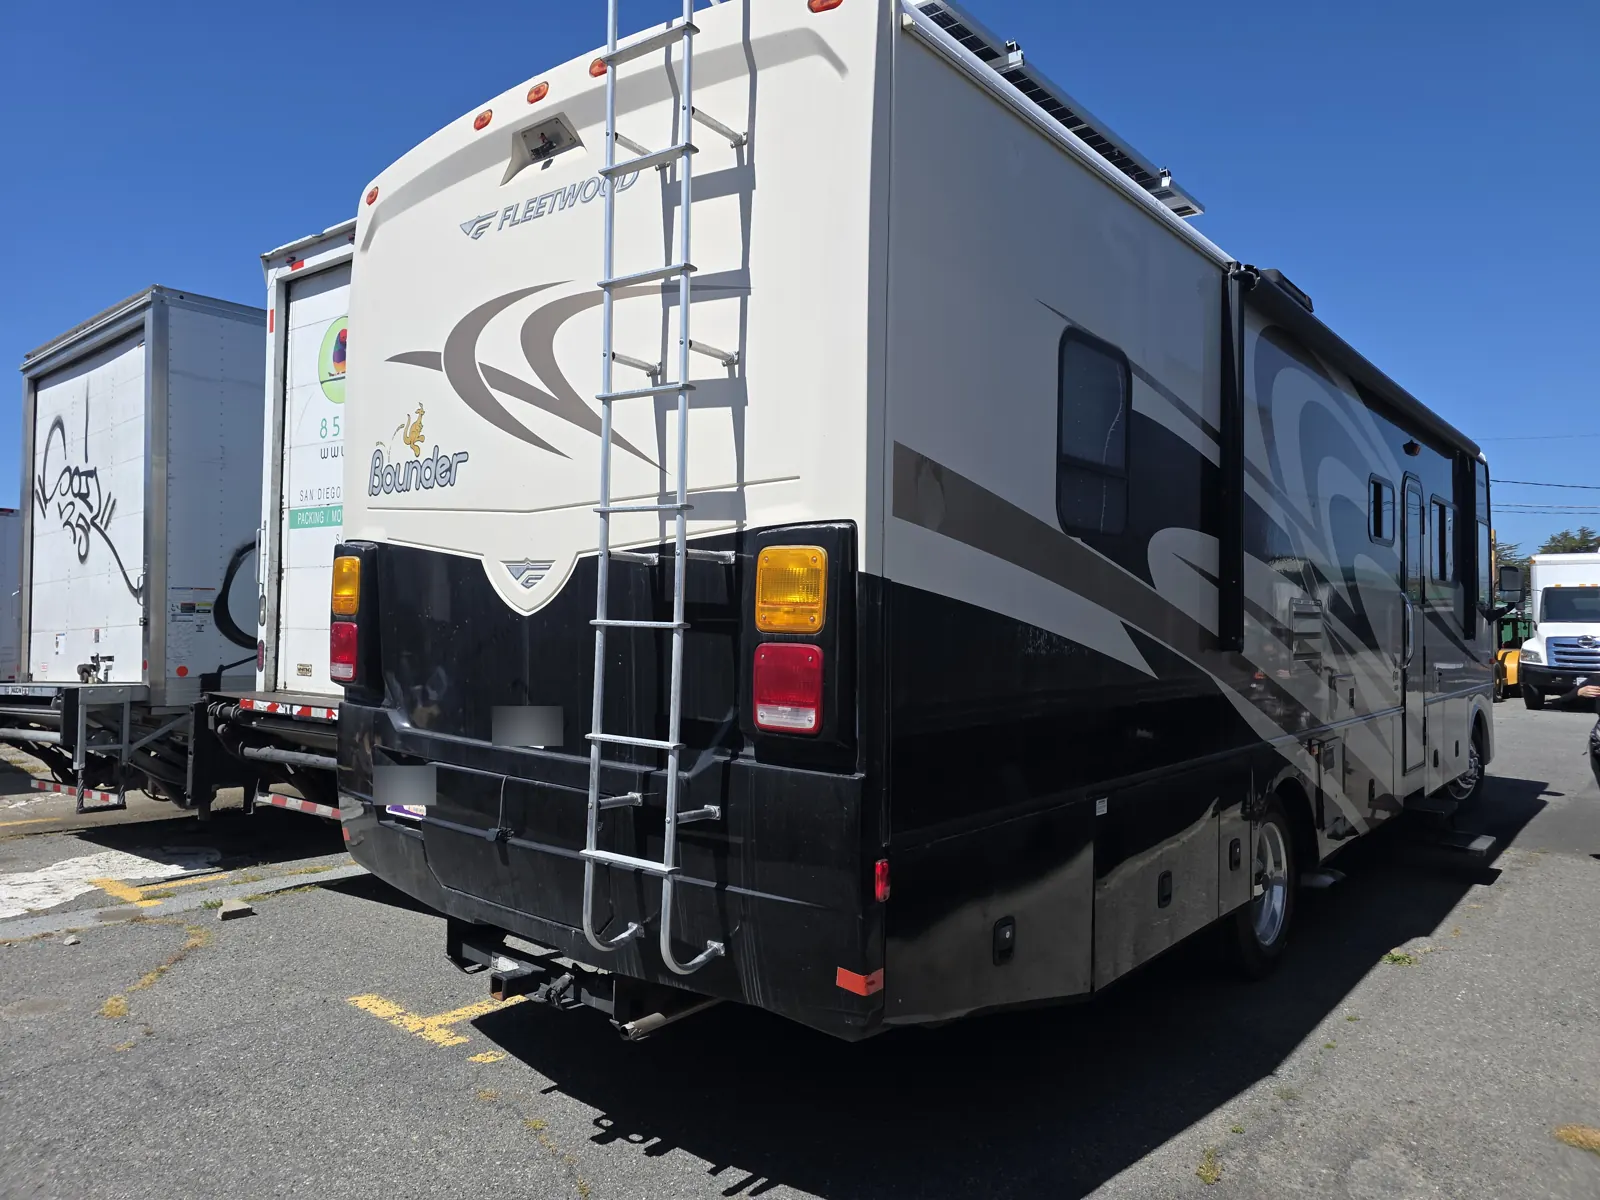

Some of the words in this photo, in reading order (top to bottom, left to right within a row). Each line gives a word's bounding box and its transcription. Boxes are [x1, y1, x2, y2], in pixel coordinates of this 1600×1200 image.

[368, 445, 469, 497] Bounder
[299, 489, 314, 502] SAN
[317, 486, 341, 500] DIEGO
[297, 510, 324, 525] PACKING
